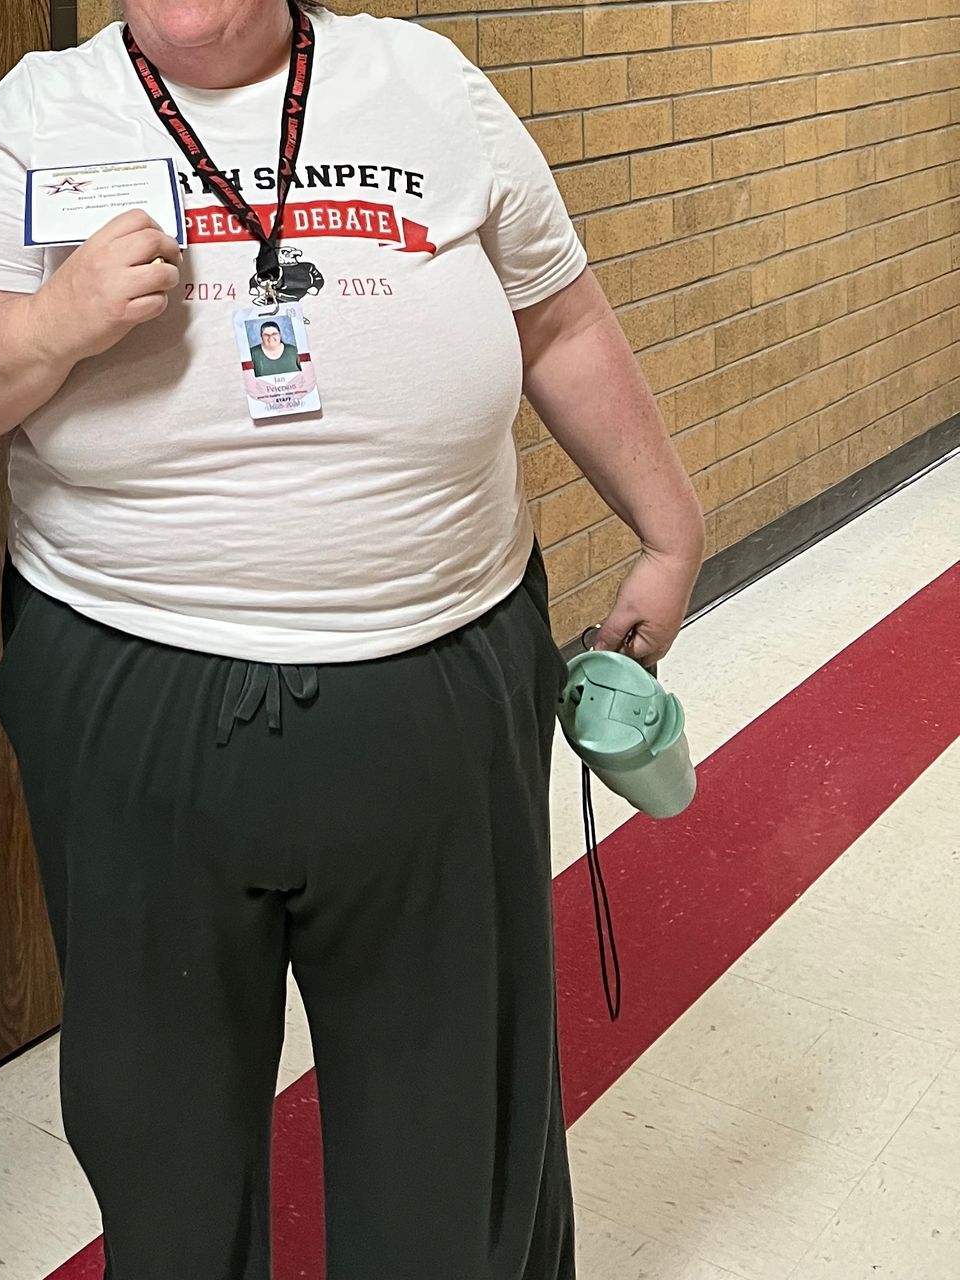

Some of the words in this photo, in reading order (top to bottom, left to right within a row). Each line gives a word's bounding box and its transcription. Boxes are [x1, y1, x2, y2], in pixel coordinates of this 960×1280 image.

[177, 169, 243, 194] RTH
[293, 207, 393, 233] DEBATE
[184, 282, 237, 301] 2024
[337, 278, 393, 296] 2025
